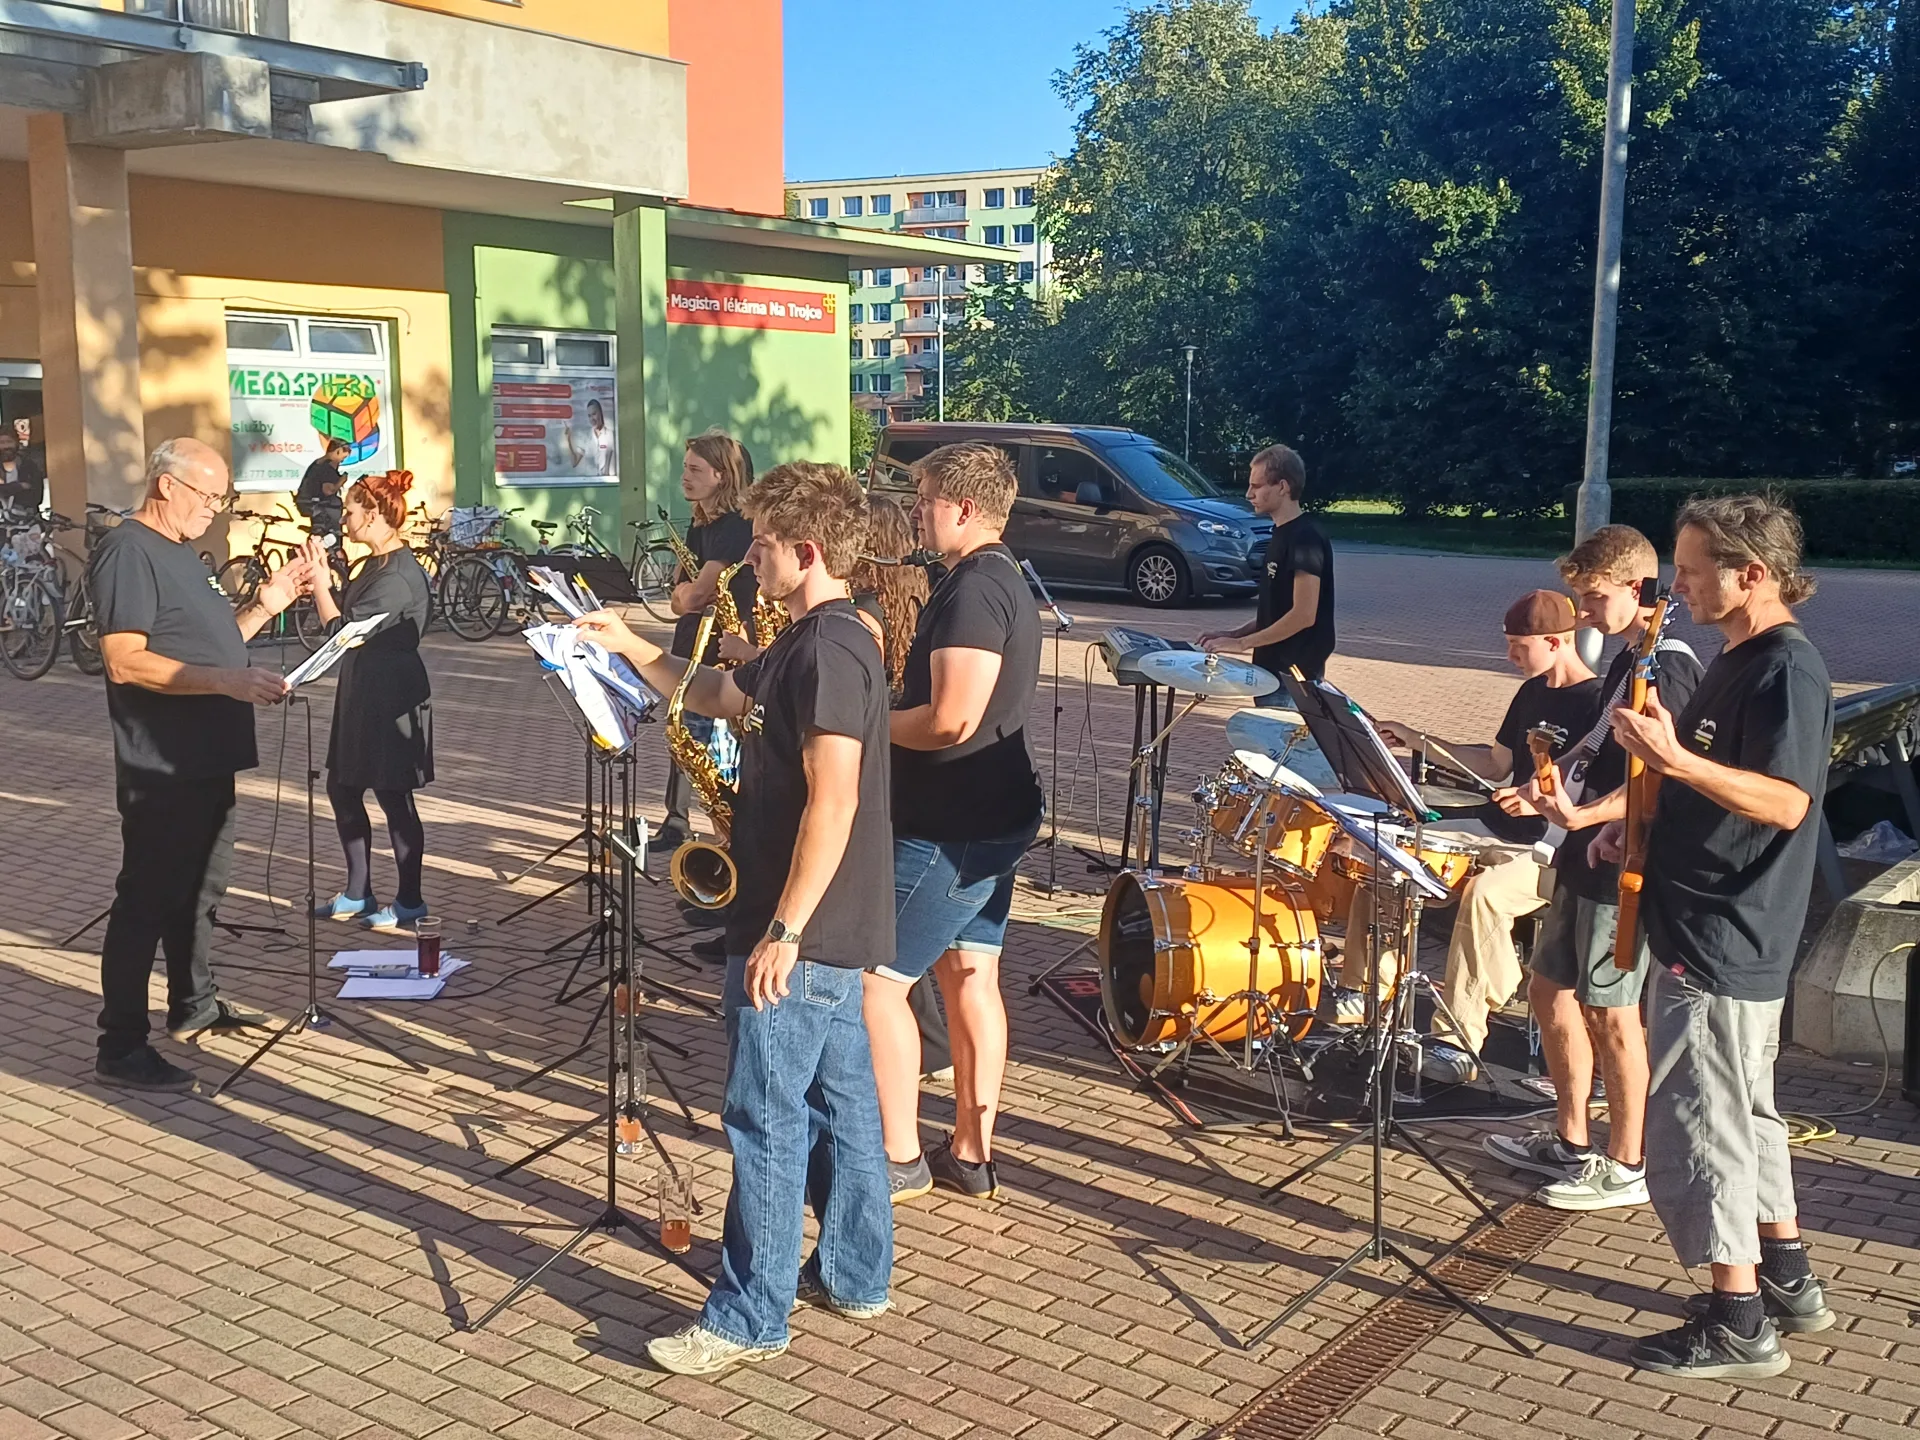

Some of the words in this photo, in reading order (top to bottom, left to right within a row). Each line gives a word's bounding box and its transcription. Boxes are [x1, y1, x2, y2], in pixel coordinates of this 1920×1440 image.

[671, 293, 720, 312] Magistra
[724, 297, 767, 315] lékárna
[769, 301, 786, 317] Na
[788, 303, 822, 321] Trojce
[232, 420, 274, 436] služby
[250, 469, 265, 478] 777
